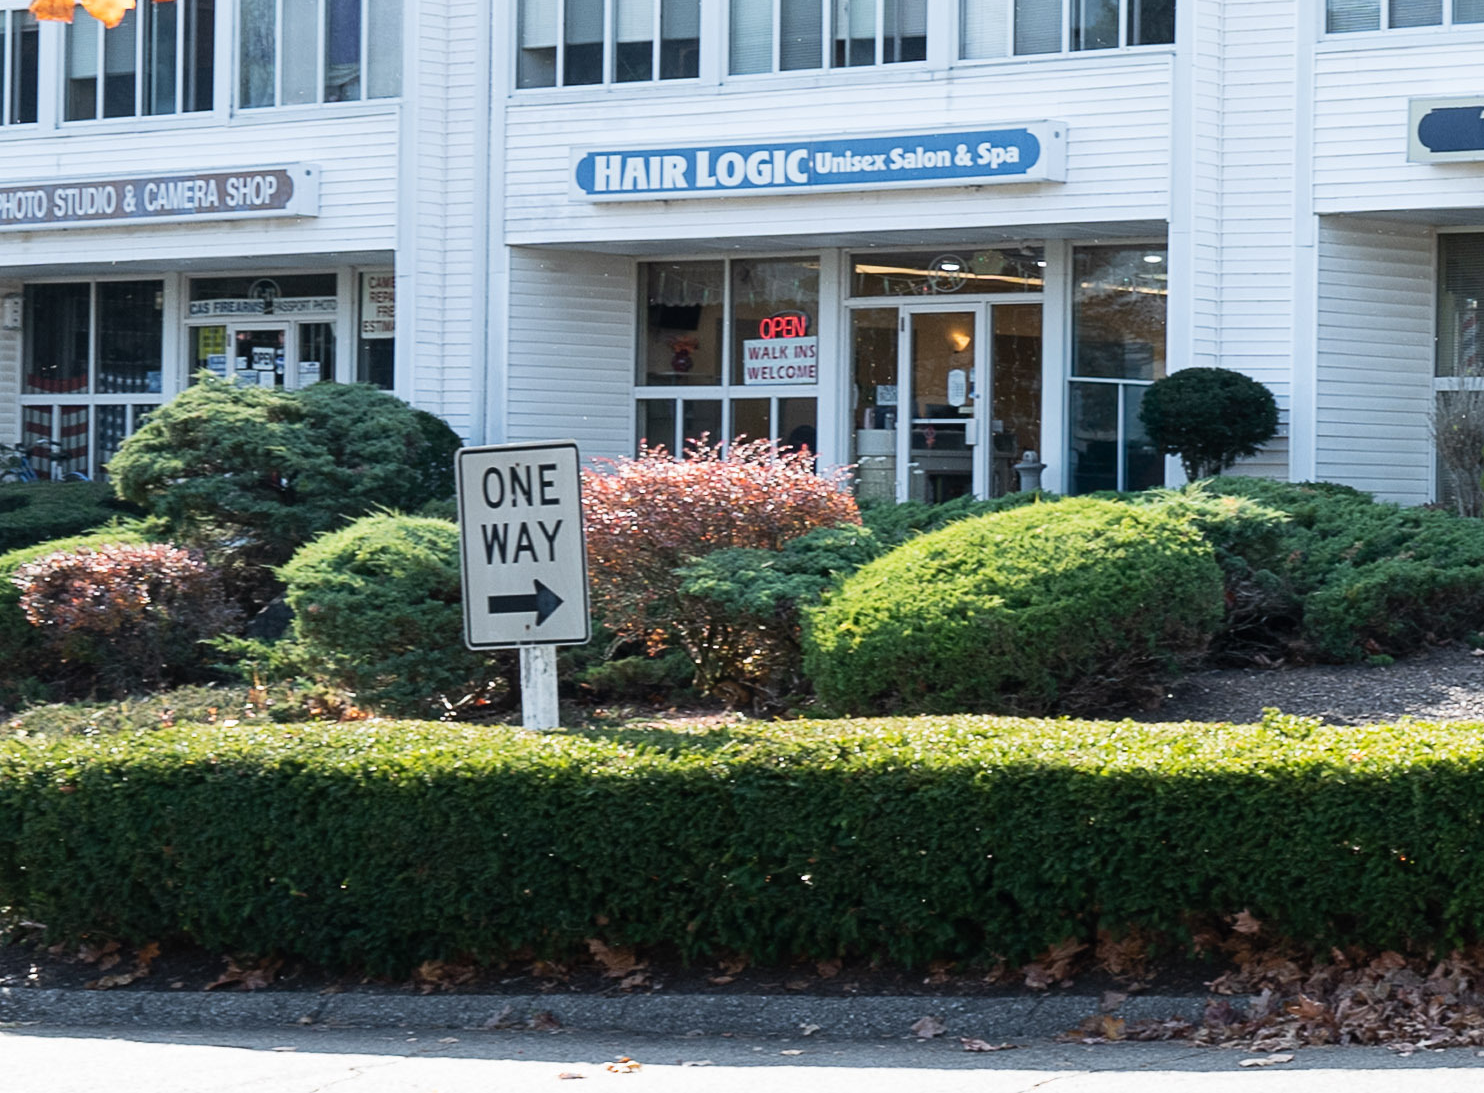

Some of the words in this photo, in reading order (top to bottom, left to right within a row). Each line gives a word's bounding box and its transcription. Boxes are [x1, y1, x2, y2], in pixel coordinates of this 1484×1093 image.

[594, 154, 688, 191] HAIR
[695, 149, 809, 188] LOGIC
[815, 151, 887, 174] Unisex
[889, 147, 950, 170] Salon
[953, 144, 975, 167] &
[977, 142, 1019, 169] Spa
[0, 190, 47, 219] HOTO
[53, 185, 117, 217] STUDIO
[123, 184, 137, 213] &
[143, 178, 219, 212] CAMERA
[225, 175, 278, 207] SHOP
[760, 316, 806, 340] OPEN
[747, 365, 816, 380] WELCOME
[748, 345, 788, 360] WALK
[794, 344, 816, 358] INS
[483, 464, 560, 509] ONE
[481, 519, 563, 565] WAY
